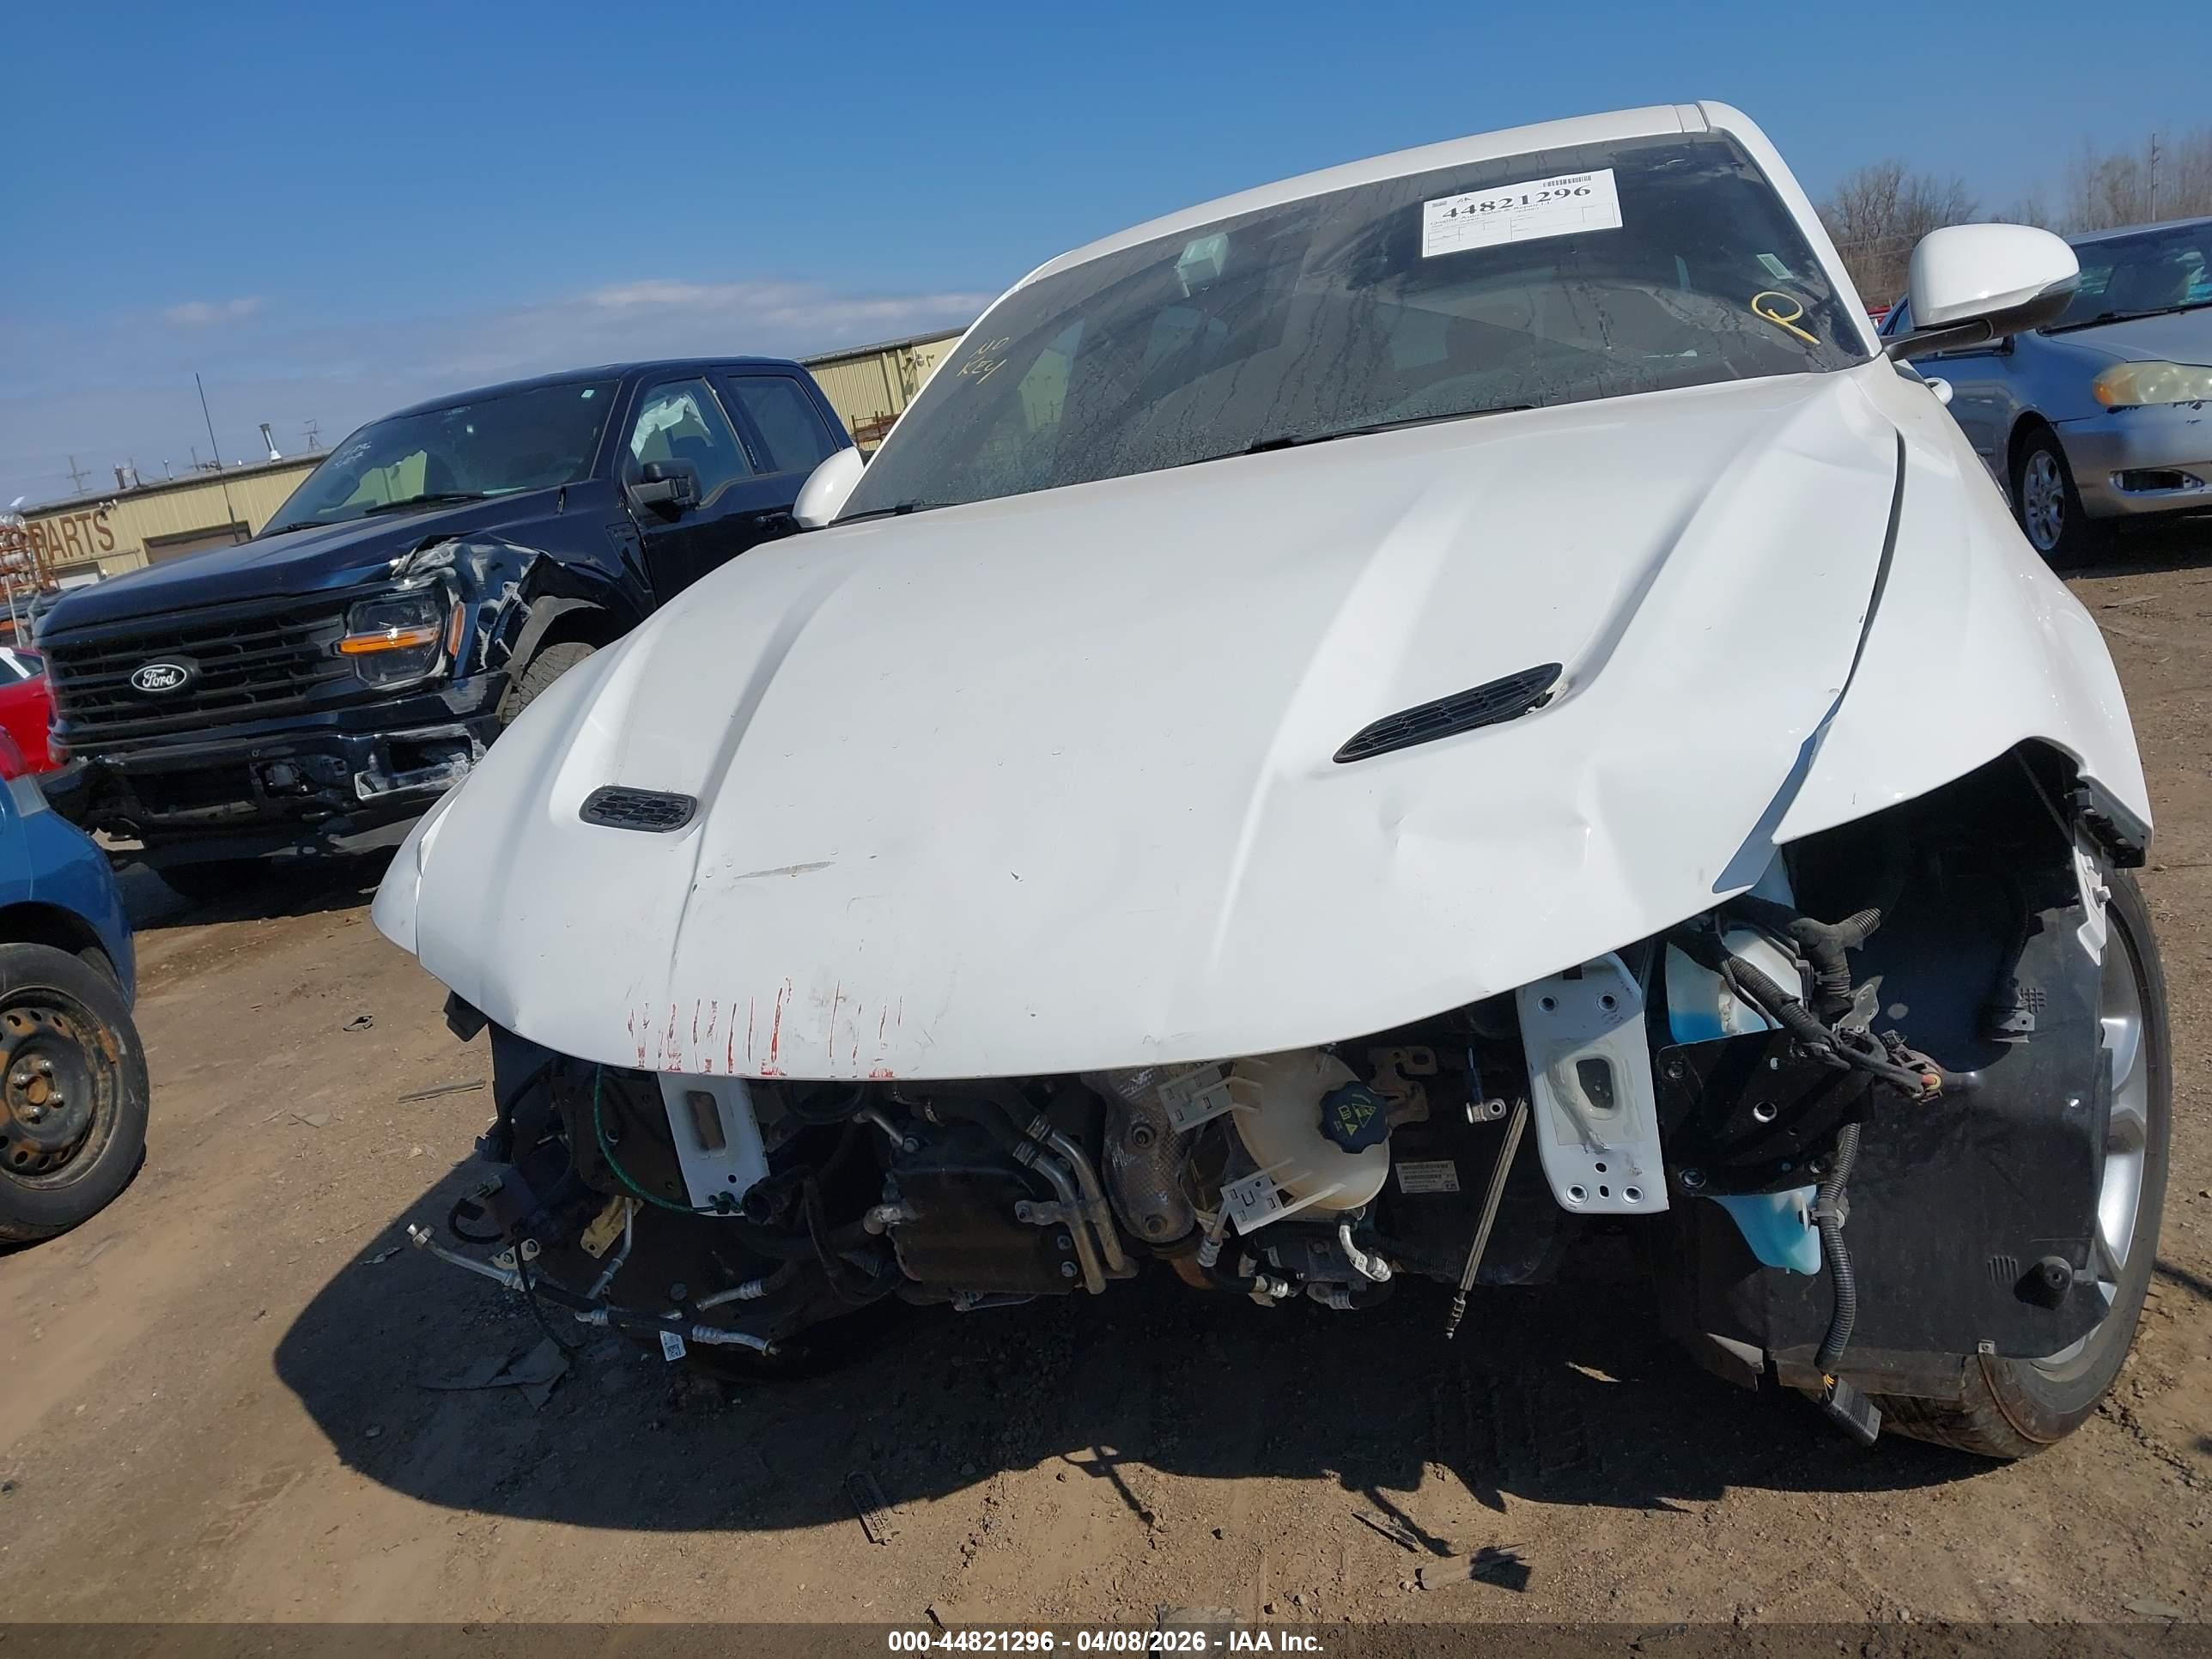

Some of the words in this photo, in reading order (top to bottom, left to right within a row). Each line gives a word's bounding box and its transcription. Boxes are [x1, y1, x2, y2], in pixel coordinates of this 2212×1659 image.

[1442, 184, 1591, 218] 44821296
[27, 509, 115, 562] PARTS
[142, 668, 176, 688] Ford
